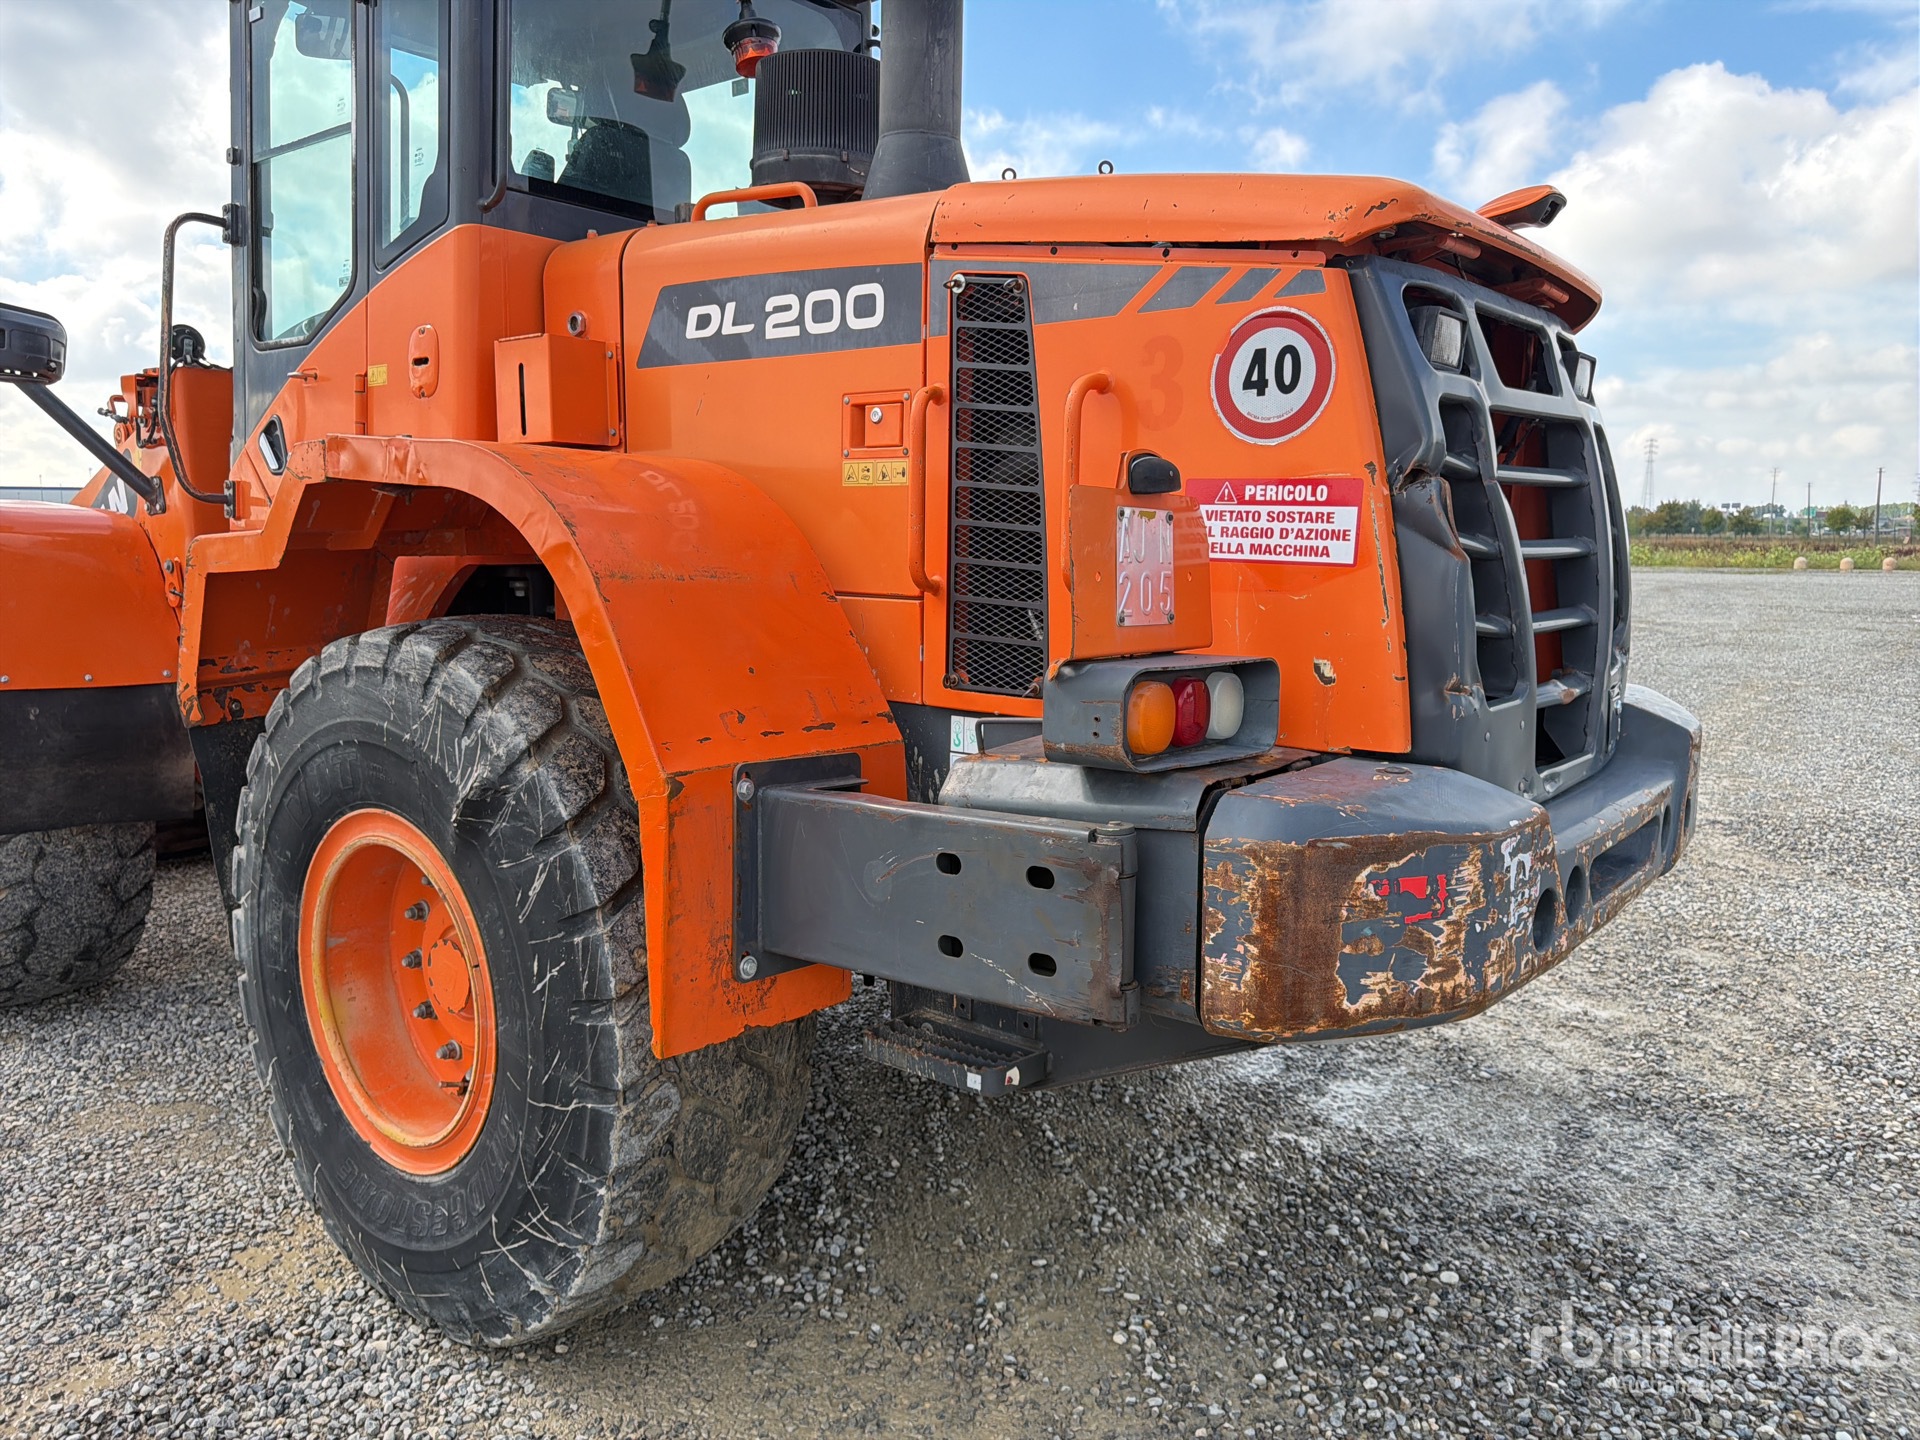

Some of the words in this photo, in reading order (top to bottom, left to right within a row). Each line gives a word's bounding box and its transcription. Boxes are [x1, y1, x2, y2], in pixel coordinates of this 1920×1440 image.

[685, 301, 755, 339] DL
[765, 283, 885, 339] 200
[1242, 344, 1302, 397] 40
[1244, 484, 1328, 502] PERICOLO
[1205, 509, 1262, 523] VIETATO
[1266, 511, 1336, 525] SOSTARE
[1220, 526, 1275, 540] RAGGIO
[1279, 527, 1352, 542] D'AZIONE
[1208, 542, 1245, 555] ELLA
[1249, 543, 1331, 559] MACCHINA
[1118, 570, 1172, 617] 205
